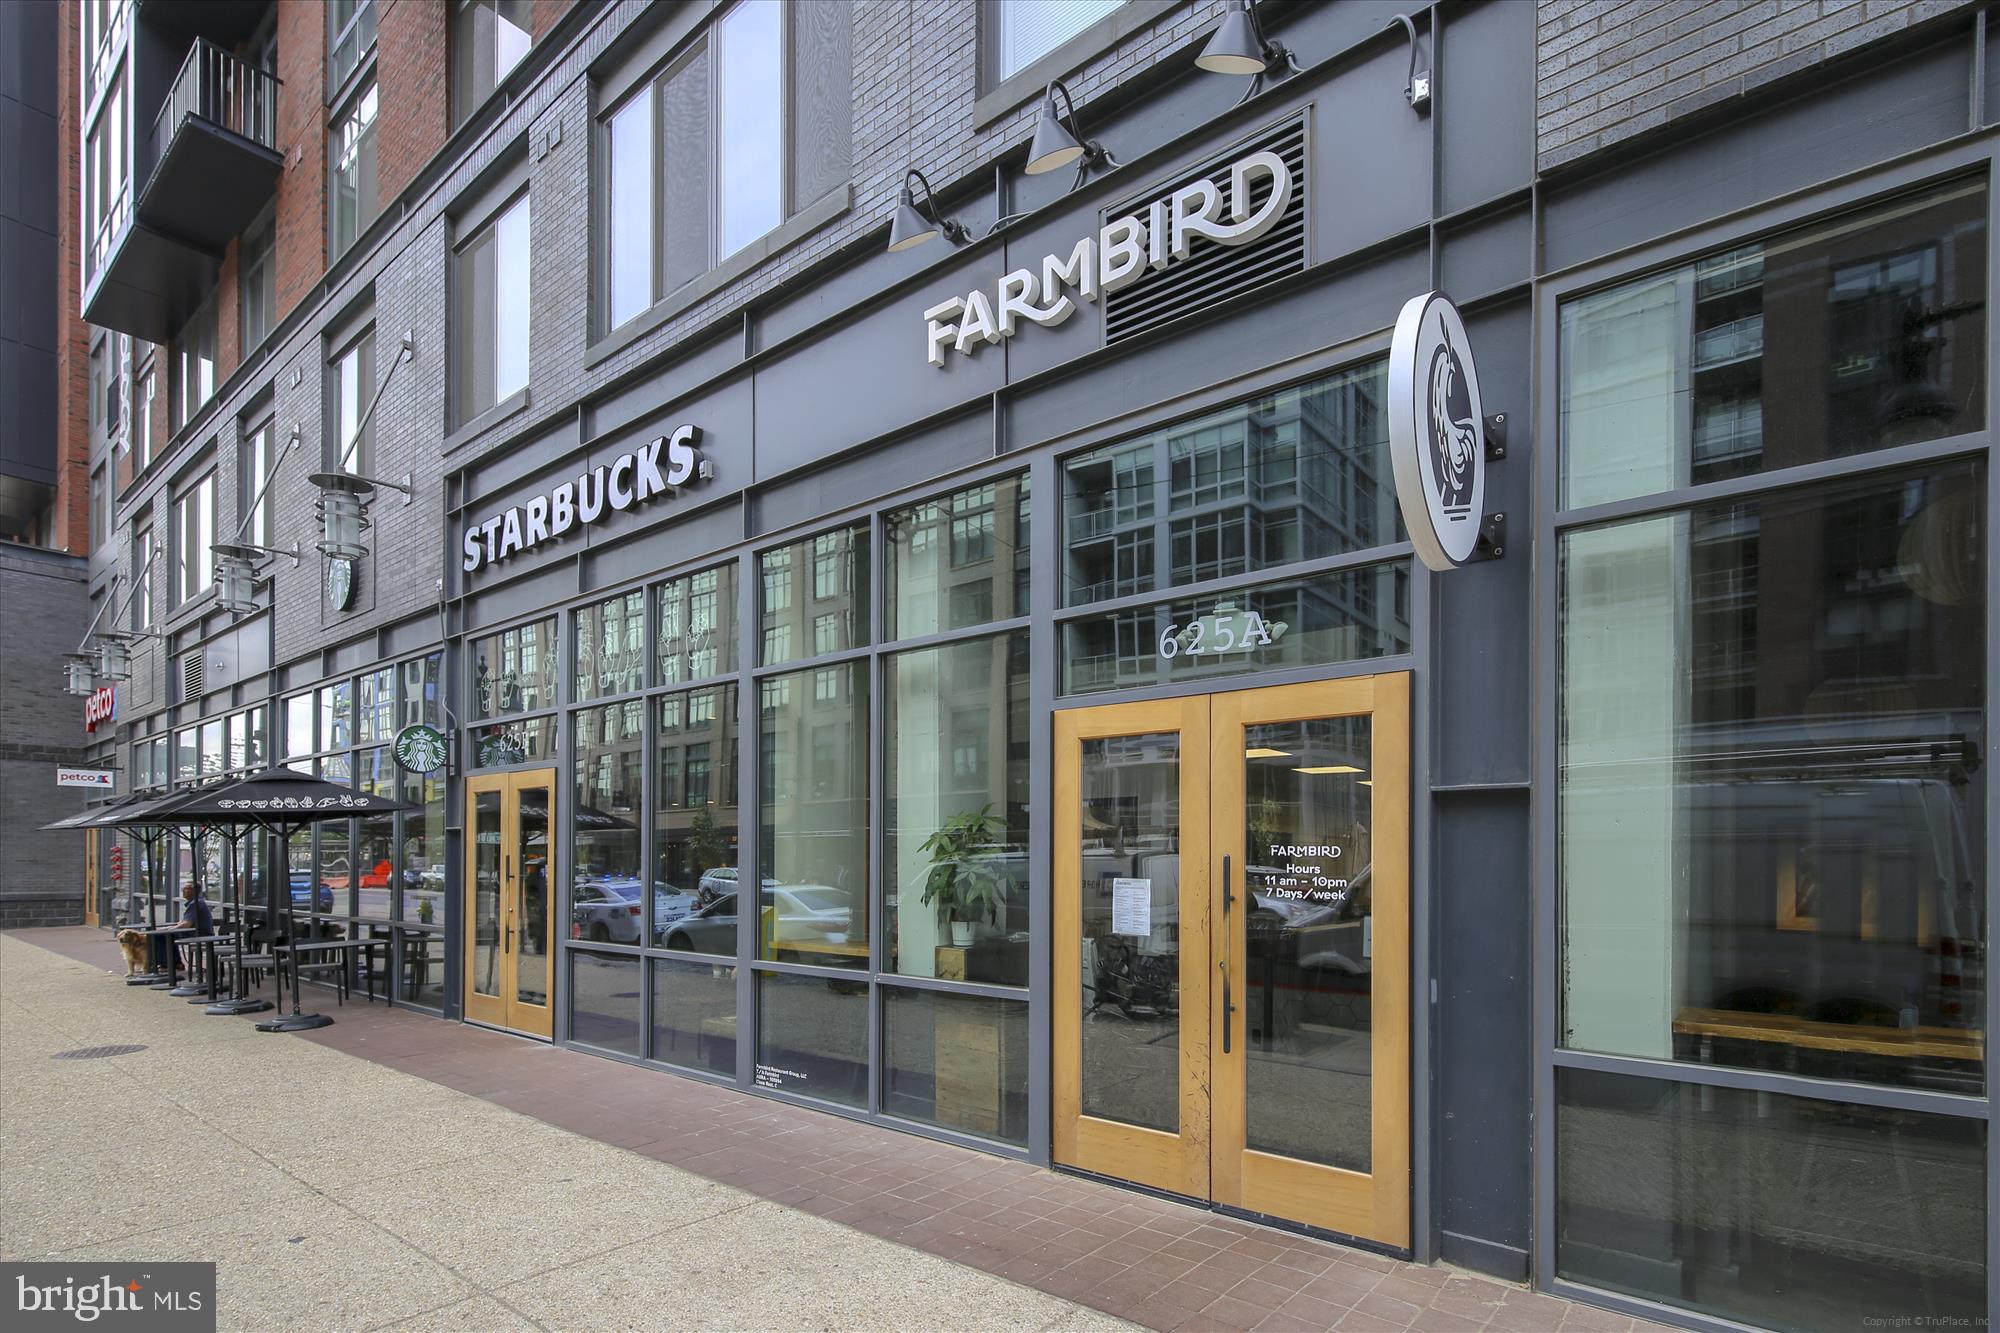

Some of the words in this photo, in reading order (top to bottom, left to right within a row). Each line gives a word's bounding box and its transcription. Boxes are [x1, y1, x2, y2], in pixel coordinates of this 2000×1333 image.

[924, 151, 1292, 367] FARMBIRD
[463, 424, 700, 573] STARBUCKS
[1160, 611, 1272, 659] 625A
[86, 688, 113, 732] petco
[60, 774, 96, 784] petco
[1270, 845, 1341, 858] FARMBIRD
[1286, 863, 1321, 874] Hours
[1265, 875, 1276, 885] 11
[1279, 877, 1297, 886] am
[1311, 876, 1347, 889] 10pm
[1266, 887, 1273, 897] 7
